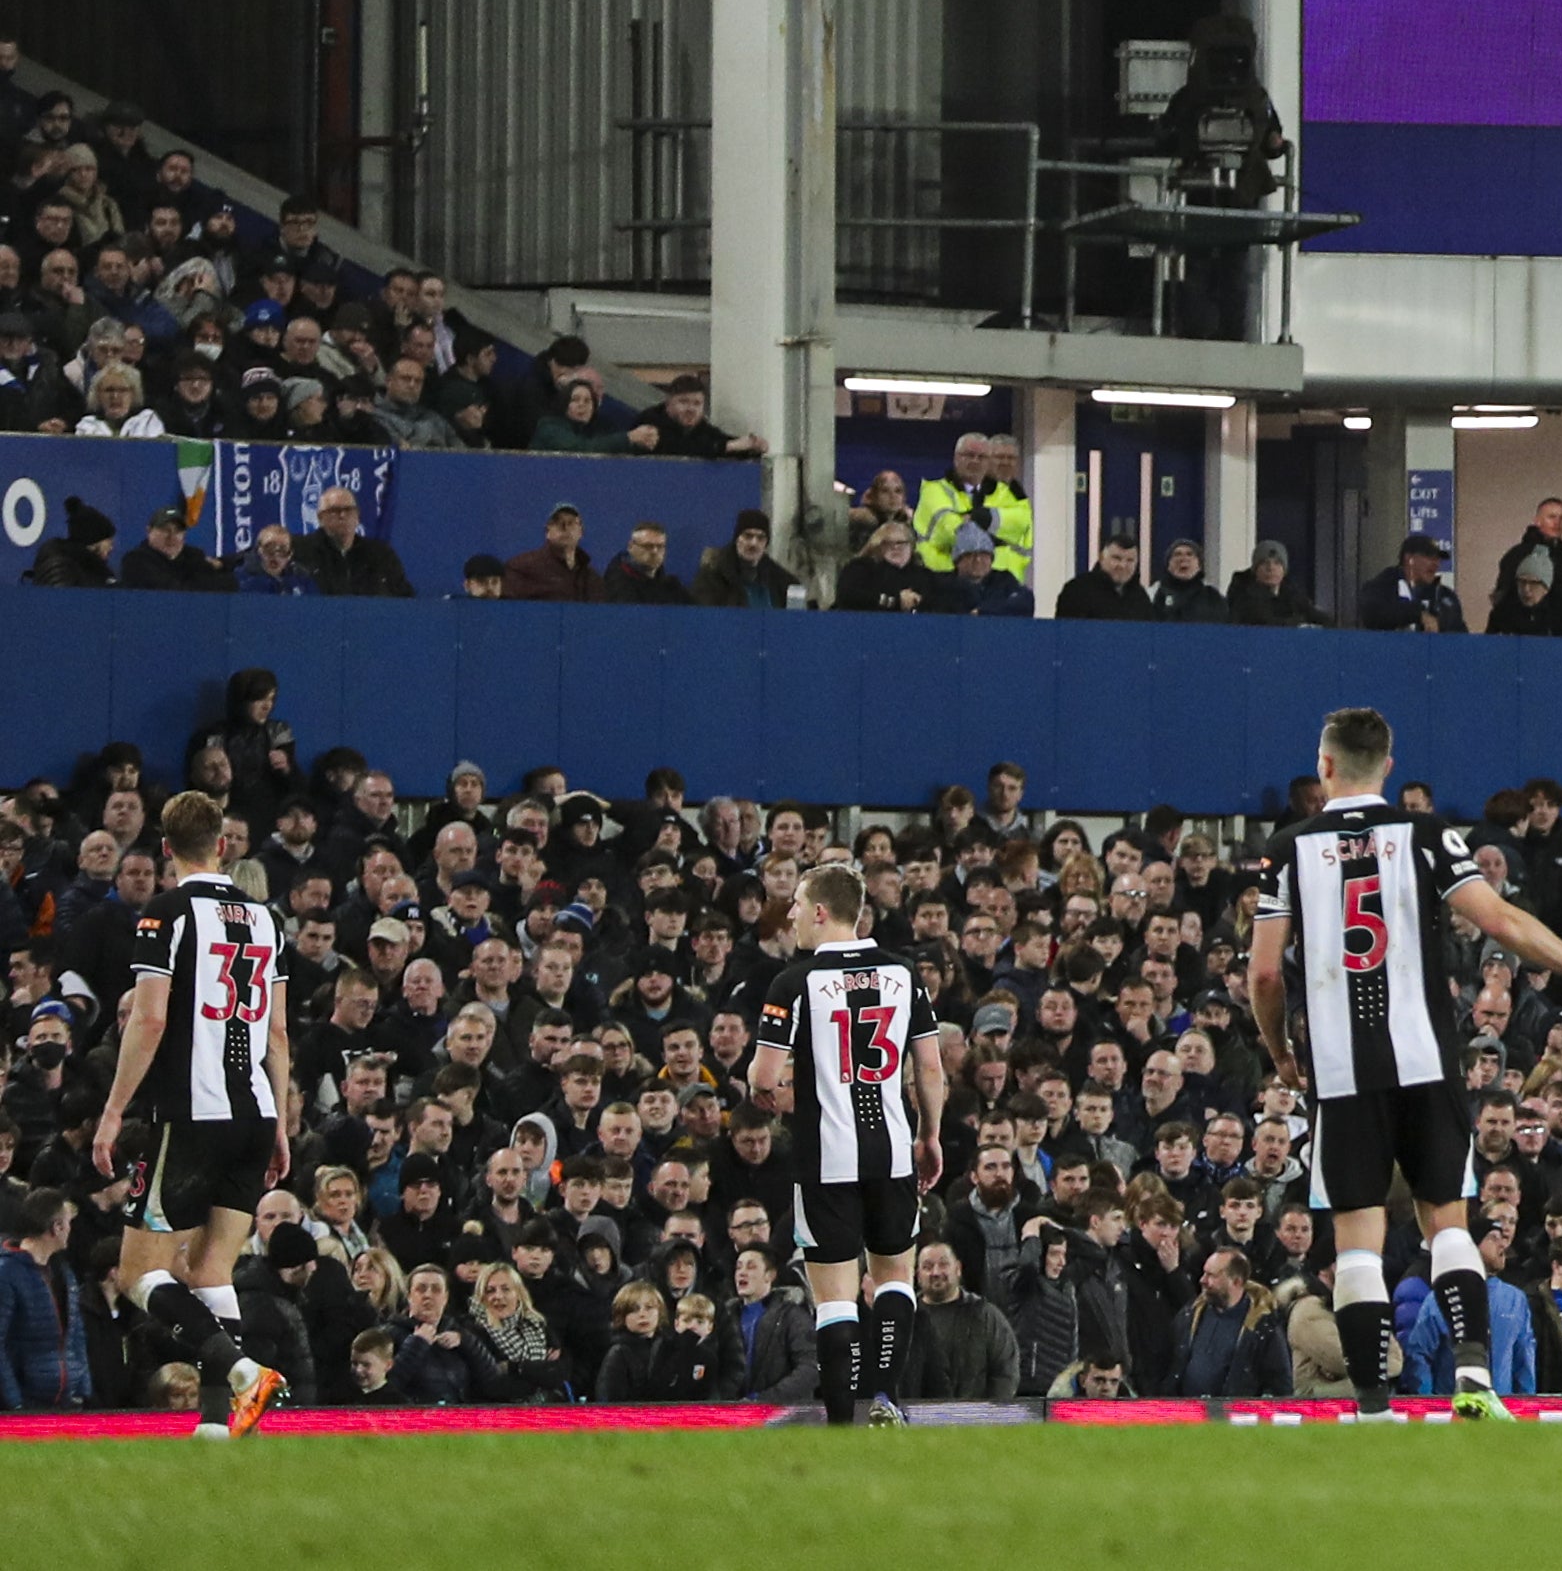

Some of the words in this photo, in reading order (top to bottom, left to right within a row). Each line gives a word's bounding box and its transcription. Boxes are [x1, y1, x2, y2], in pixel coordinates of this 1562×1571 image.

[263, 469, 281, 495] 18
[1410, 488, 1439, 500] EXIT
[215, 904, 257, 927] BURN
[1341, 874, 1389, 973] 5
[201, 942, 273, 1024] 33
[819, 971, 904, 1000] TARGETT
[830, 1005, 900, 1085] 13
[1445, 1286, 1465, 1343] ASTORE
[850, 1342, 861, 1390] CASTORE
[879, 1320, 895, 1369] CASTORE
[1378, 1318, 1391, 1387] ASTORE
